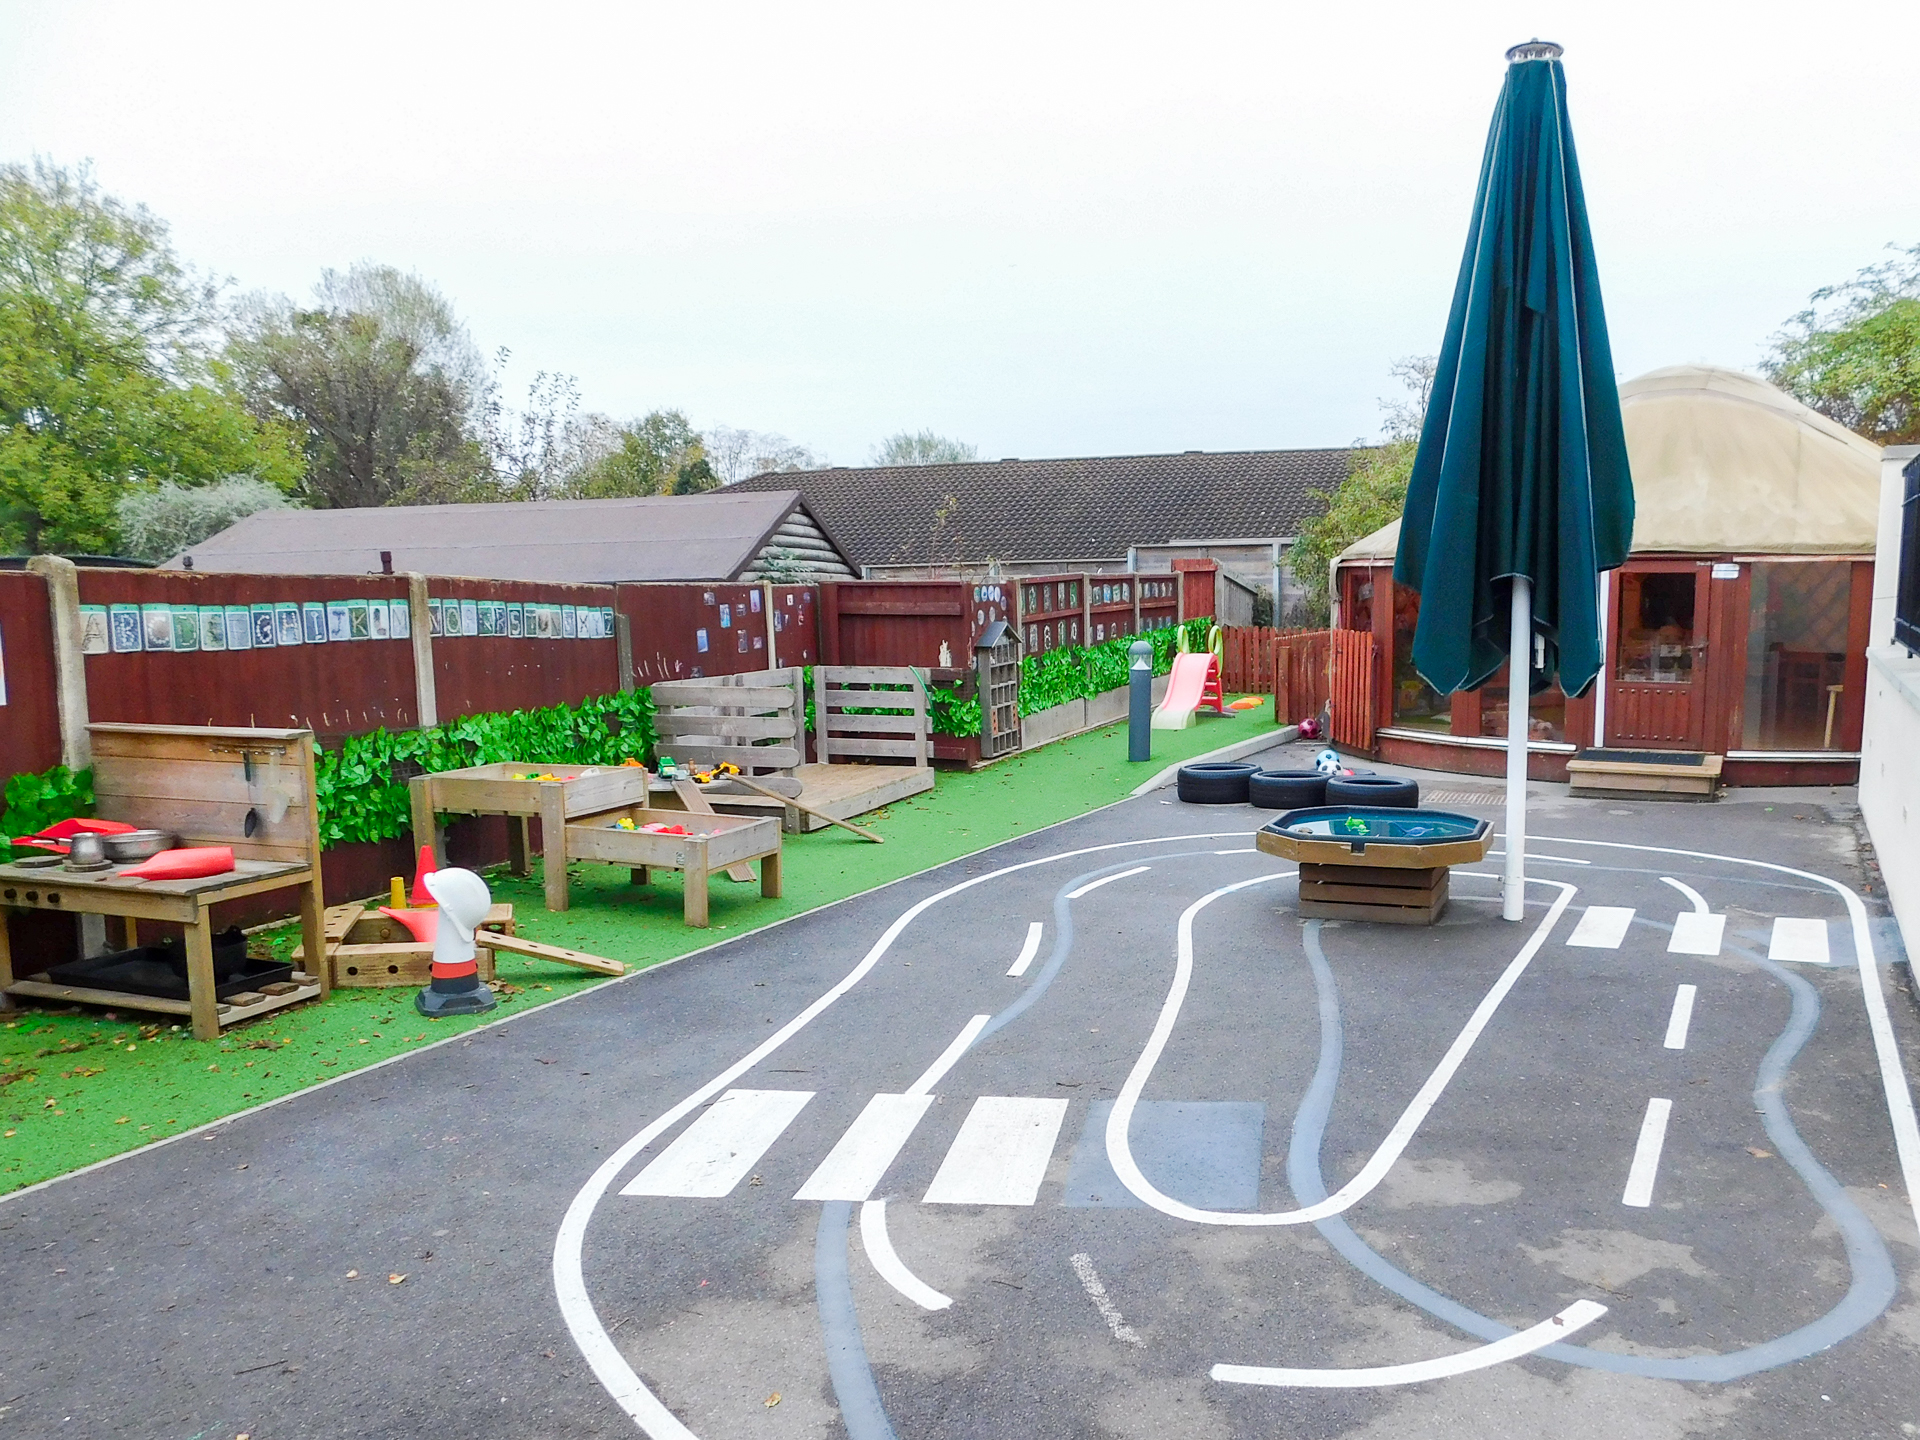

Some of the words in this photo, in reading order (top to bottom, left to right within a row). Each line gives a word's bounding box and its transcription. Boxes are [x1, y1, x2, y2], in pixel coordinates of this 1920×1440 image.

[114, 613, 136, 646] B
[256, 614, 273, 644] G
[281, 611, 298, 641] H
[352, 610, 367, 636] K
[510, 610, 521, 635] S
